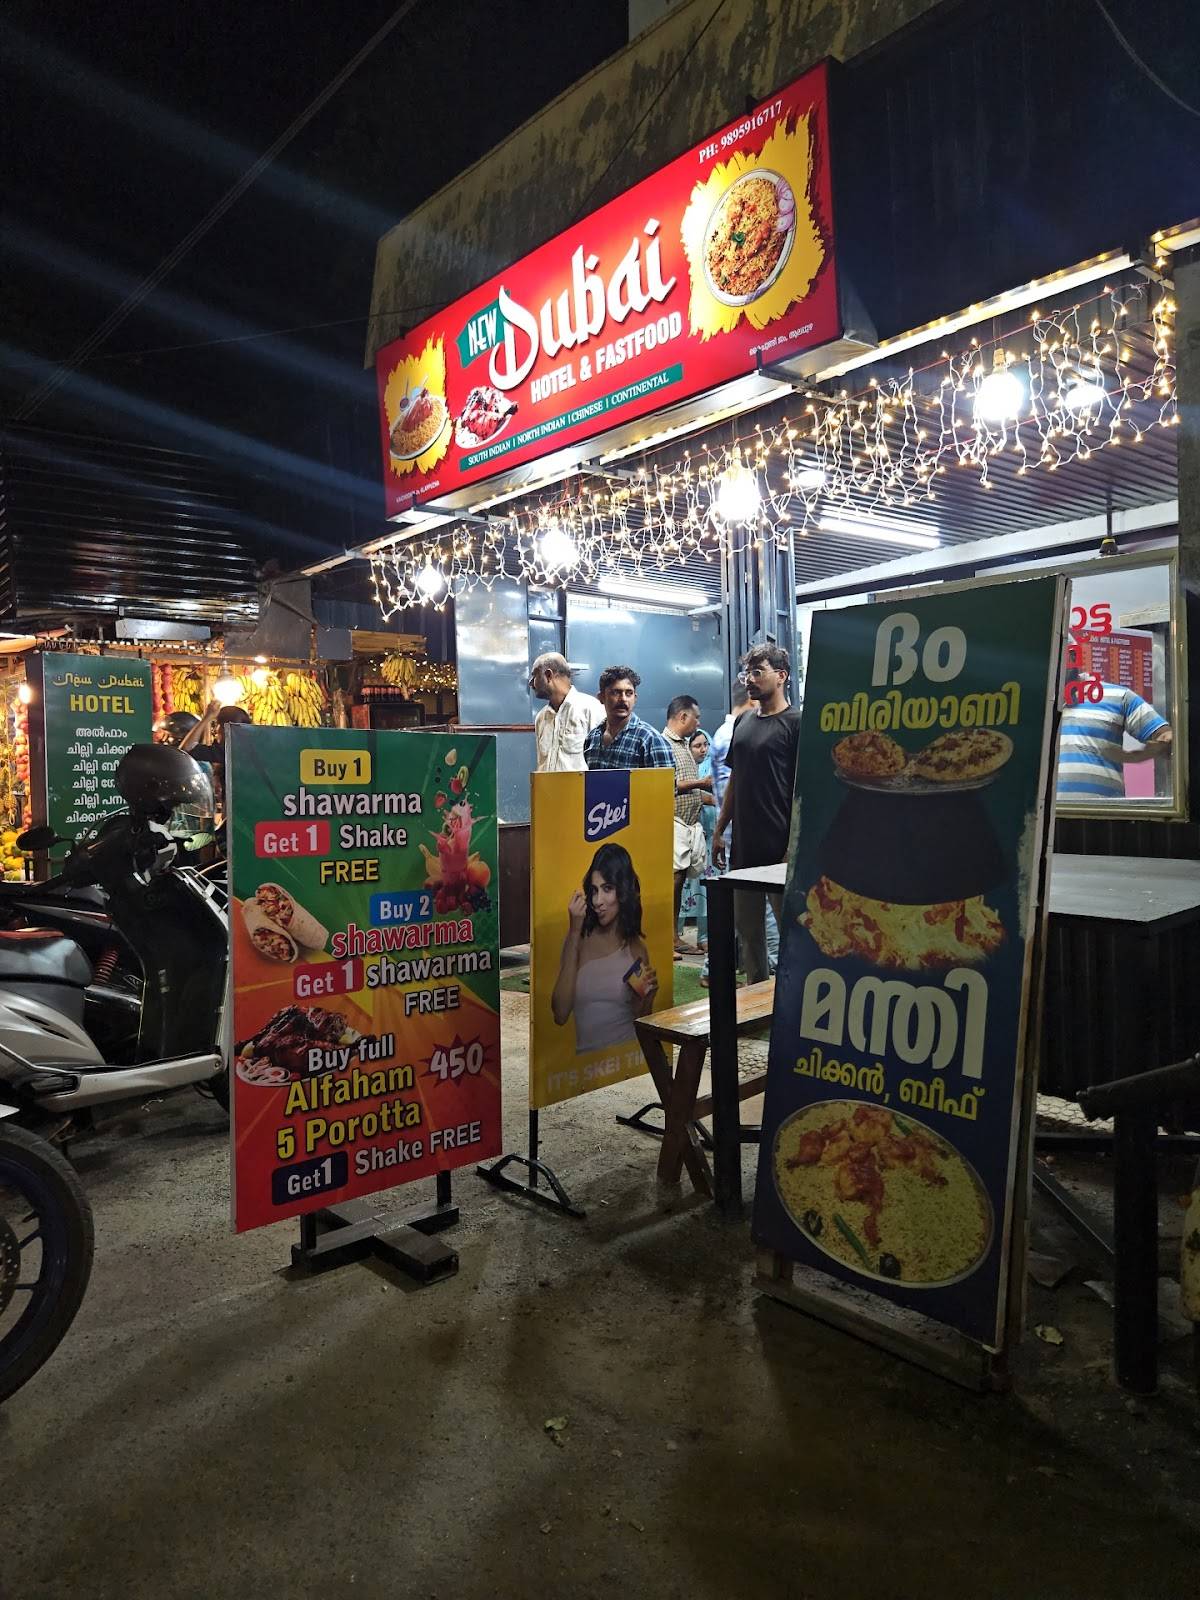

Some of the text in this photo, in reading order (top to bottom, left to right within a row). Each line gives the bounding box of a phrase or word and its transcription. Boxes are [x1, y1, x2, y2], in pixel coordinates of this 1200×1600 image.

[699, 99, 782, 164] PH: 9895916717
[467, 218, 677, 391] NEW Dubai
[531, 311, 682, 403] HOTEL & FASTFOOD
[468, 373, 669, 466] SOUTH INDIAN NORTH INDIAN CHINESE CONTINENTAL
[871, 612, 968, 687] ദം
[97, 673, 145, 689] Dubai
[70, 694, 135, 713] HOTEL
[820, 681, 1021, 733] ബിരിയാണി
[67, 742, 93, 757] ചില്ലി
[72, 759, 98, 775] ചില്ലി
[313, 758, 362, 779] Buy 1
[72, 776, 98, 791] ചില്ലി
[73, 793, 99, 808] ചില്ലി
[283, 787, 422, 816] shawarma
[587, 798, 628, 836] Skei
[263, 824, 408, 854] Get 1 Shake
[320, 859, 379, 884] FREE
[380, 896, 430, 921] Buy 2
[331, 918, 474, 959] shawarma
[296, 950, 492, 998] Get 1 shawarma
[405, 986, 460, 1016] FREE
[800, 967, 989, 1079] മന്തി
[308, 1034, 394, 1073] Buy full
[430, 1043, 484, 1080] 450
[584, 1055, 621, 1080] SKEI
[285, 1065, 413, 1116] Alfaham
[900, 1077, 985, 1121] ബീഫ്
[276, 1102, 421, 1160] 5 Porotta
[355, 1139, 423, 1175] Shake
[430, 1121, 481, 1153] FREE
